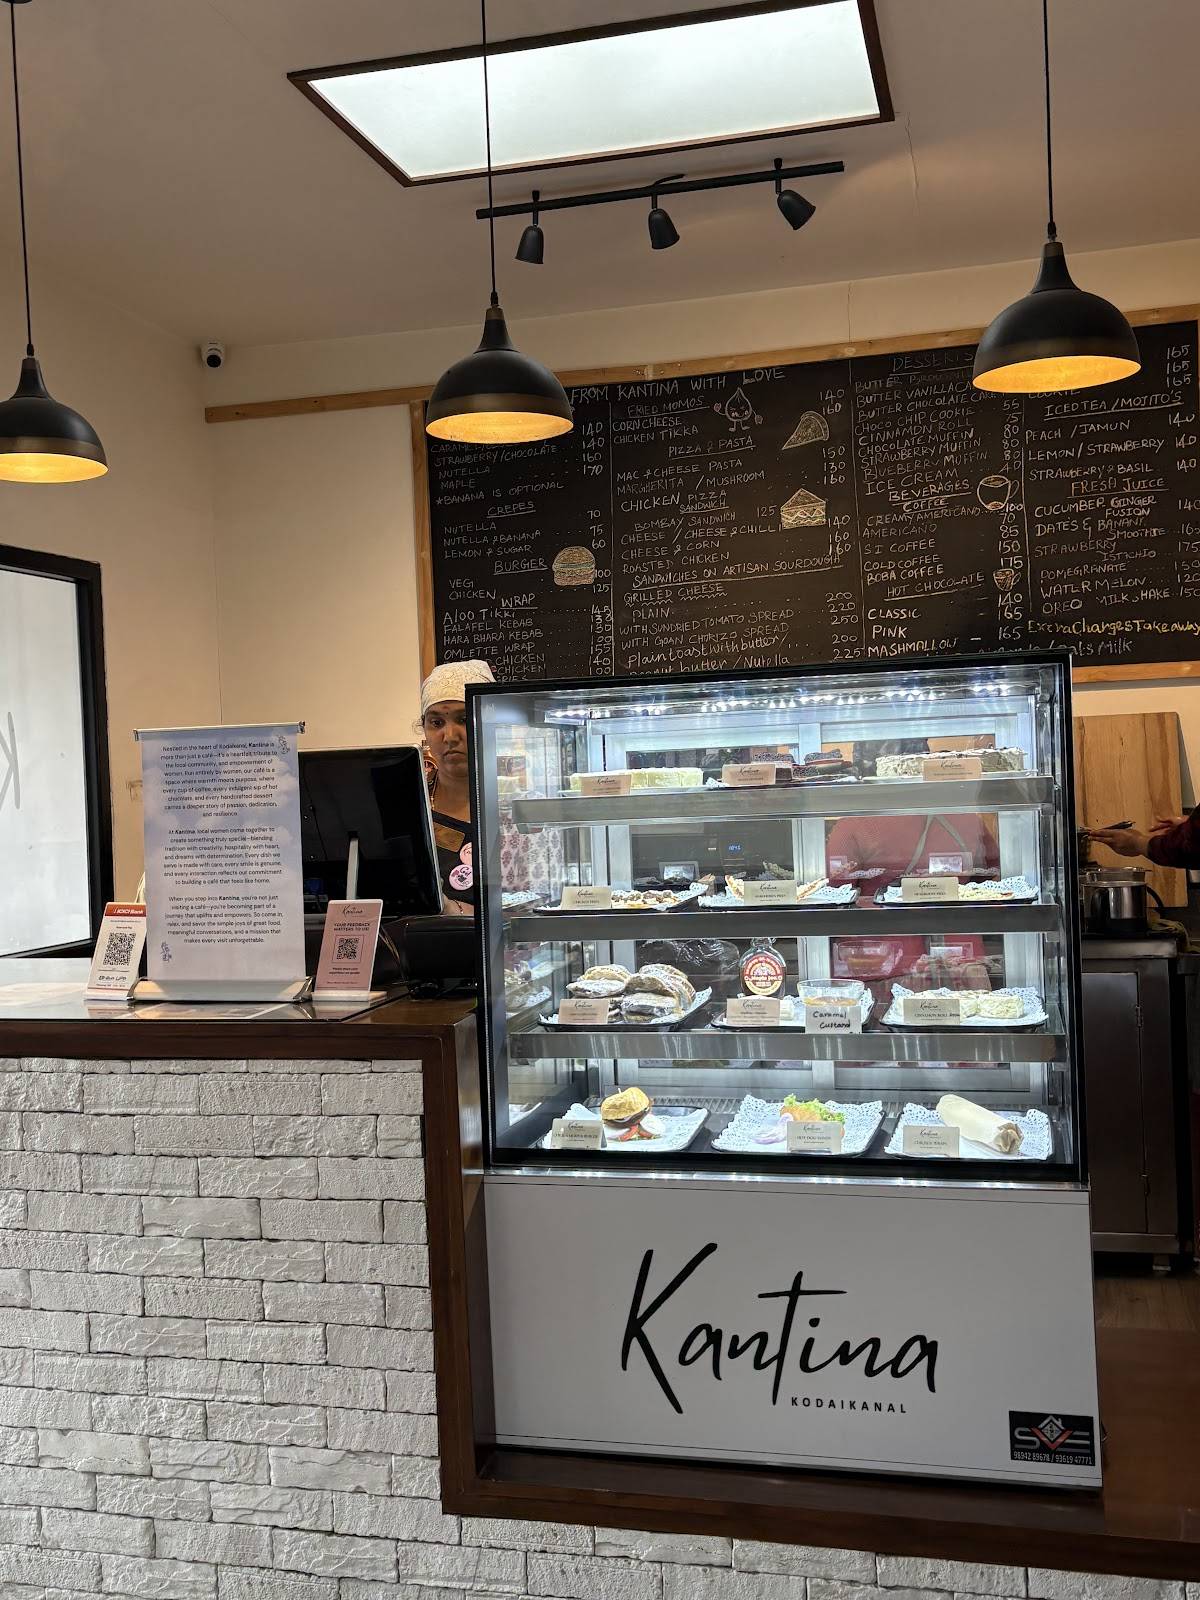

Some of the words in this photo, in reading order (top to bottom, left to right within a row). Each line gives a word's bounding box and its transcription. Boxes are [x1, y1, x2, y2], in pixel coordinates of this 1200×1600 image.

[1167, 345, 1191, 360] 165
[1166, 361, 1191, 374] 165
[571, 385, 609, 404] FROM
[617, 379, 678, 399] KANTINA
[691, 375, 725, 390] WITH
[743, 367, 785, 385] LOVE
[1166, 374, 1191, 387] 165
[856, 392, 904, 408] BUTTER
[1002, 399, 1020, 410] 55
[858, 405, 906, 423] BUTTER
[906, 396, 968, 411] CHOCOLATE
[855, 421, 892, 436] CHOCO
[897, 412, 926, 427] CHIP
[930, 407, 975, 423] COOKIE
[613, 432, 654, 444] CHICKEN
[858, 425, 932, 446] CINNAMON
[938, 419, 974, 432] ROLL
[1003, 425, 1019, 438] 80
[1025, 428, 1061, 444] PEACH
[1079, 420, 1130, 435] JAMUN
[582, 438, 605, 450] 140
[858, 438, 924, 458] CHOCOLATE
[928, 428, 974, 443] MUFFIN
[1002, 439, 1019, 449] 80
[1087, 439, 1165, 455] STRAWBERRY
[1175, 434, 1197, 448] 140
[582, 452, 602, 462] 160
[669, 445, 702, 457] PIZZA
[861, 448, 935, 469] STRAWBERRY
[939, 440, 981, 454] MUFFIN
[944, 451, 988, 467] MUFFIN
[1177, 458, 1197, 472] 140
[438, 465, 490, 479] NUTELLA
[653, 464, 701, 477] CHEESE
[708, 458, 742, 471] PASTA
[1029, 464, 1105, 481] STRAWBERRY
[1117, 463, 1154, 474] BASIL
[440, 478, 476, 489] MAPLE
[706, 470, 766, 488] MUSHROOM
[865, 478, 896, 495] ICE
[901, 468, 958, 486] CREAM
[509, 481, 564, 496] OPTIONAL
[889, 479, 970, 500] BEVERAGES
[1071, 477, 1117, 497] FRESH
[1123, 478, 1165, 492] JUICE
[487, 501, 534, 516] CREPES
[620, 492, 680, 512] CHICKEN
[687, 490, 727, 503] PIZZA
[903, 499, 949, 512] COFFEE
[1034, 497, 1106, 518] CUCUMBER
[1110, 495, 1157, 508] GINGER
[687, 512, 736, 526] SANDWICH
[756, 506, 776, 518] 125
[917, 507, 980, 522] AMERICANO
[1105, 508, 1150, 519] FUSION
[444, 522, 497, 534] NUTELLA
[621, 532, 666, 545] CHEESE
[684, 525, 727, 539] CHEESE
[863, 524, 938, 538] AMERICANO
[1000, 525, 1019, 538] 85
[443, 536, 489, 547] NUTELLA
[500, 530, 541, 543] BANANA
[591, 539, 606, 549] 60
[890, 538, 936, 552] COFFEE
[444, 549, 482, 559] LEMON
[496, 545, 532, 556] SUGAR
[621, 547, 668, 560] CHEESE
[686, 540, 720, 552] CORN
[998, 540, 1021, 554] 150
[1034, 542, 1117, 558] STRAWBERRY
[494, 558, 548, 573] BURGER
[623, 559, 674, 574] ROASTED
[682, 552, 730, 566] CHICKEN
[863, 561, 899, 572] COLD
[900, 555, 940, 569] COFFEE
[1001, 557, 1023, 569] 175
[632, 571, 698, 588] SANDWICHES
[703, 567, 717, 577] ON
[722, 563, 769, 575] ARTISAN
[773, 554, 841, 572] SOURDOUGH
[867, 572, 896, 586] BOBA
[900, 564, 944, 580] COFFEE
[678, 583, 725, 598] CHEESE
[887, 585, 909, 598] HOT
[915, 572, 985, 593] CHOCOLATE
[449, 589, 496, 600] CHICKEN
[501, 593, 536, 607] WRAP
[825, 592, 852, 602] 200
[828, 602, 856, 612] 220
[868, 608, 922, 620] CLASSIC
[1042, 599, 1083, 614] OREO
[619, 623, 649, 635] WITH
[649, 621, 700, 635] SUNDRIED
[703, 614, 744, 629] TOMATO
[750, 609, 794, 623] SPREAD
[632, 608, 670, 622] PLAIN
[831, 614, 859, 625] 250
[444, 620, 493, 635] FALAFEL
[500, 618, 533, 629] KEBAB
[872, 625, 908, 639] PINK
[998, 626, 1023, 640] 165
[444, 635, 470, 646] HARA
[473, 632, 505, 643] BHARA
[509, 629, 543, 640] KEBAB
[621, 636, 649, 650] WITH
[688, 630, 738, 645] CHORIZO
[744, 623, 790, 637] SPREAD
[832, 634, 858, 644] 200
[444, 646, 498, 660] OMLETTE
[505, 642, 535, 652] WRAP
[833, 648, 861, 660] 225
[496, 653, 545, 665] CHICKEN
[628, 652, 667, 668] Plain
[497, 664, 546, 676] CHICKEN
[343, 905, 363, 918] Kantina
[621, 1242, 939, 1414] Kantina
[791, 1396, 908, 1414] KODAIKANAL
